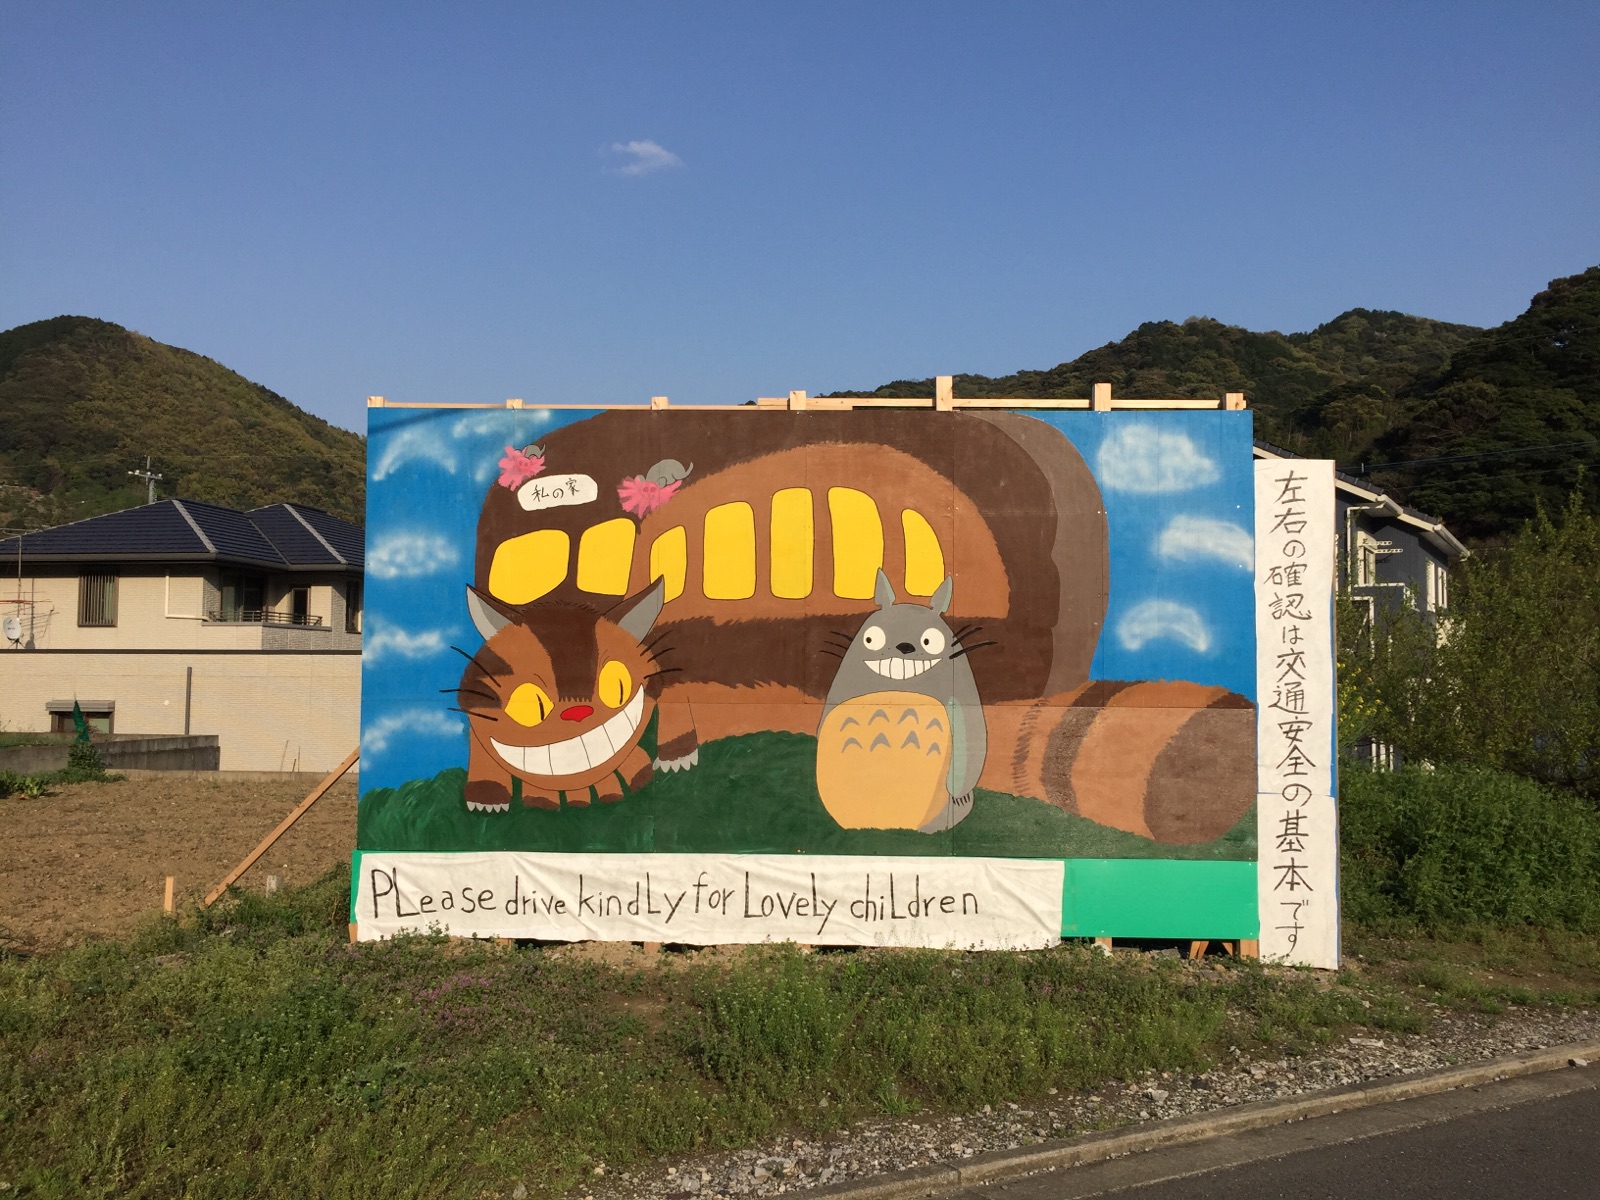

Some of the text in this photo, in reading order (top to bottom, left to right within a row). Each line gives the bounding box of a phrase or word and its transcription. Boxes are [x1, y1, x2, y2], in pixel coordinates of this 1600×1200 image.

[531, 477, 580, 502] 私の家
[1264, 470, 1317, 954] 左右の確認は交通安全の基本です
[505, 875, 567, 916] drive
[692, 871, 736, 916] for
